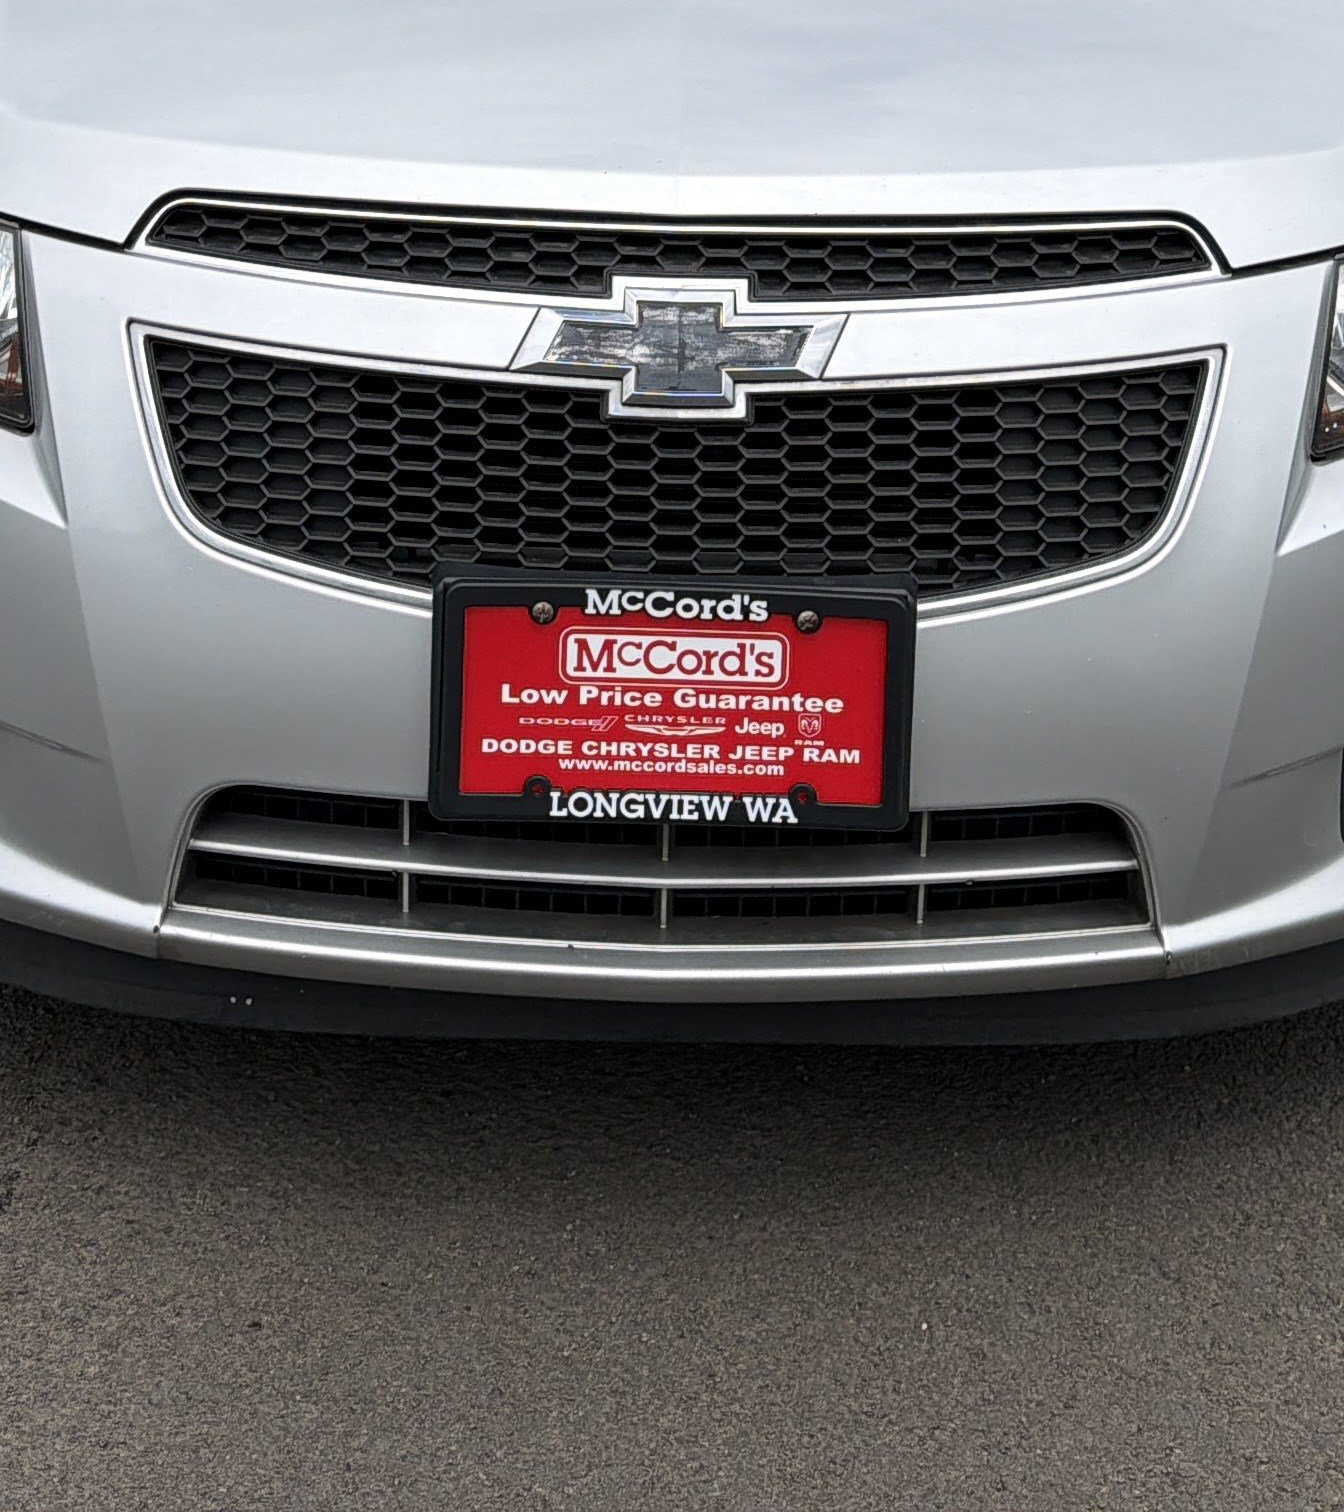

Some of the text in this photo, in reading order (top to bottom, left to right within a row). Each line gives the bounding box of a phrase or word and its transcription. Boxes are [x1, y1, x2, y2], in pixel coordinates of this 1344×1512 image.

[585, 588, 769, 622] McCord's
[572, 637, 776, 678] McCord's
[501, 683, 845, 714] Low Price Guarantee
[518, 713, 785, 739] DODGE CHRYSLER Jeep
[481, 738, 861, 764] DODGE CHRYSLER JEEP RAM
[793, 739, 825, 747] RAM
[558, 758, 785, 776] www.mccordsales.com
[549, 790, 799, 825] LONGVIEW WA
